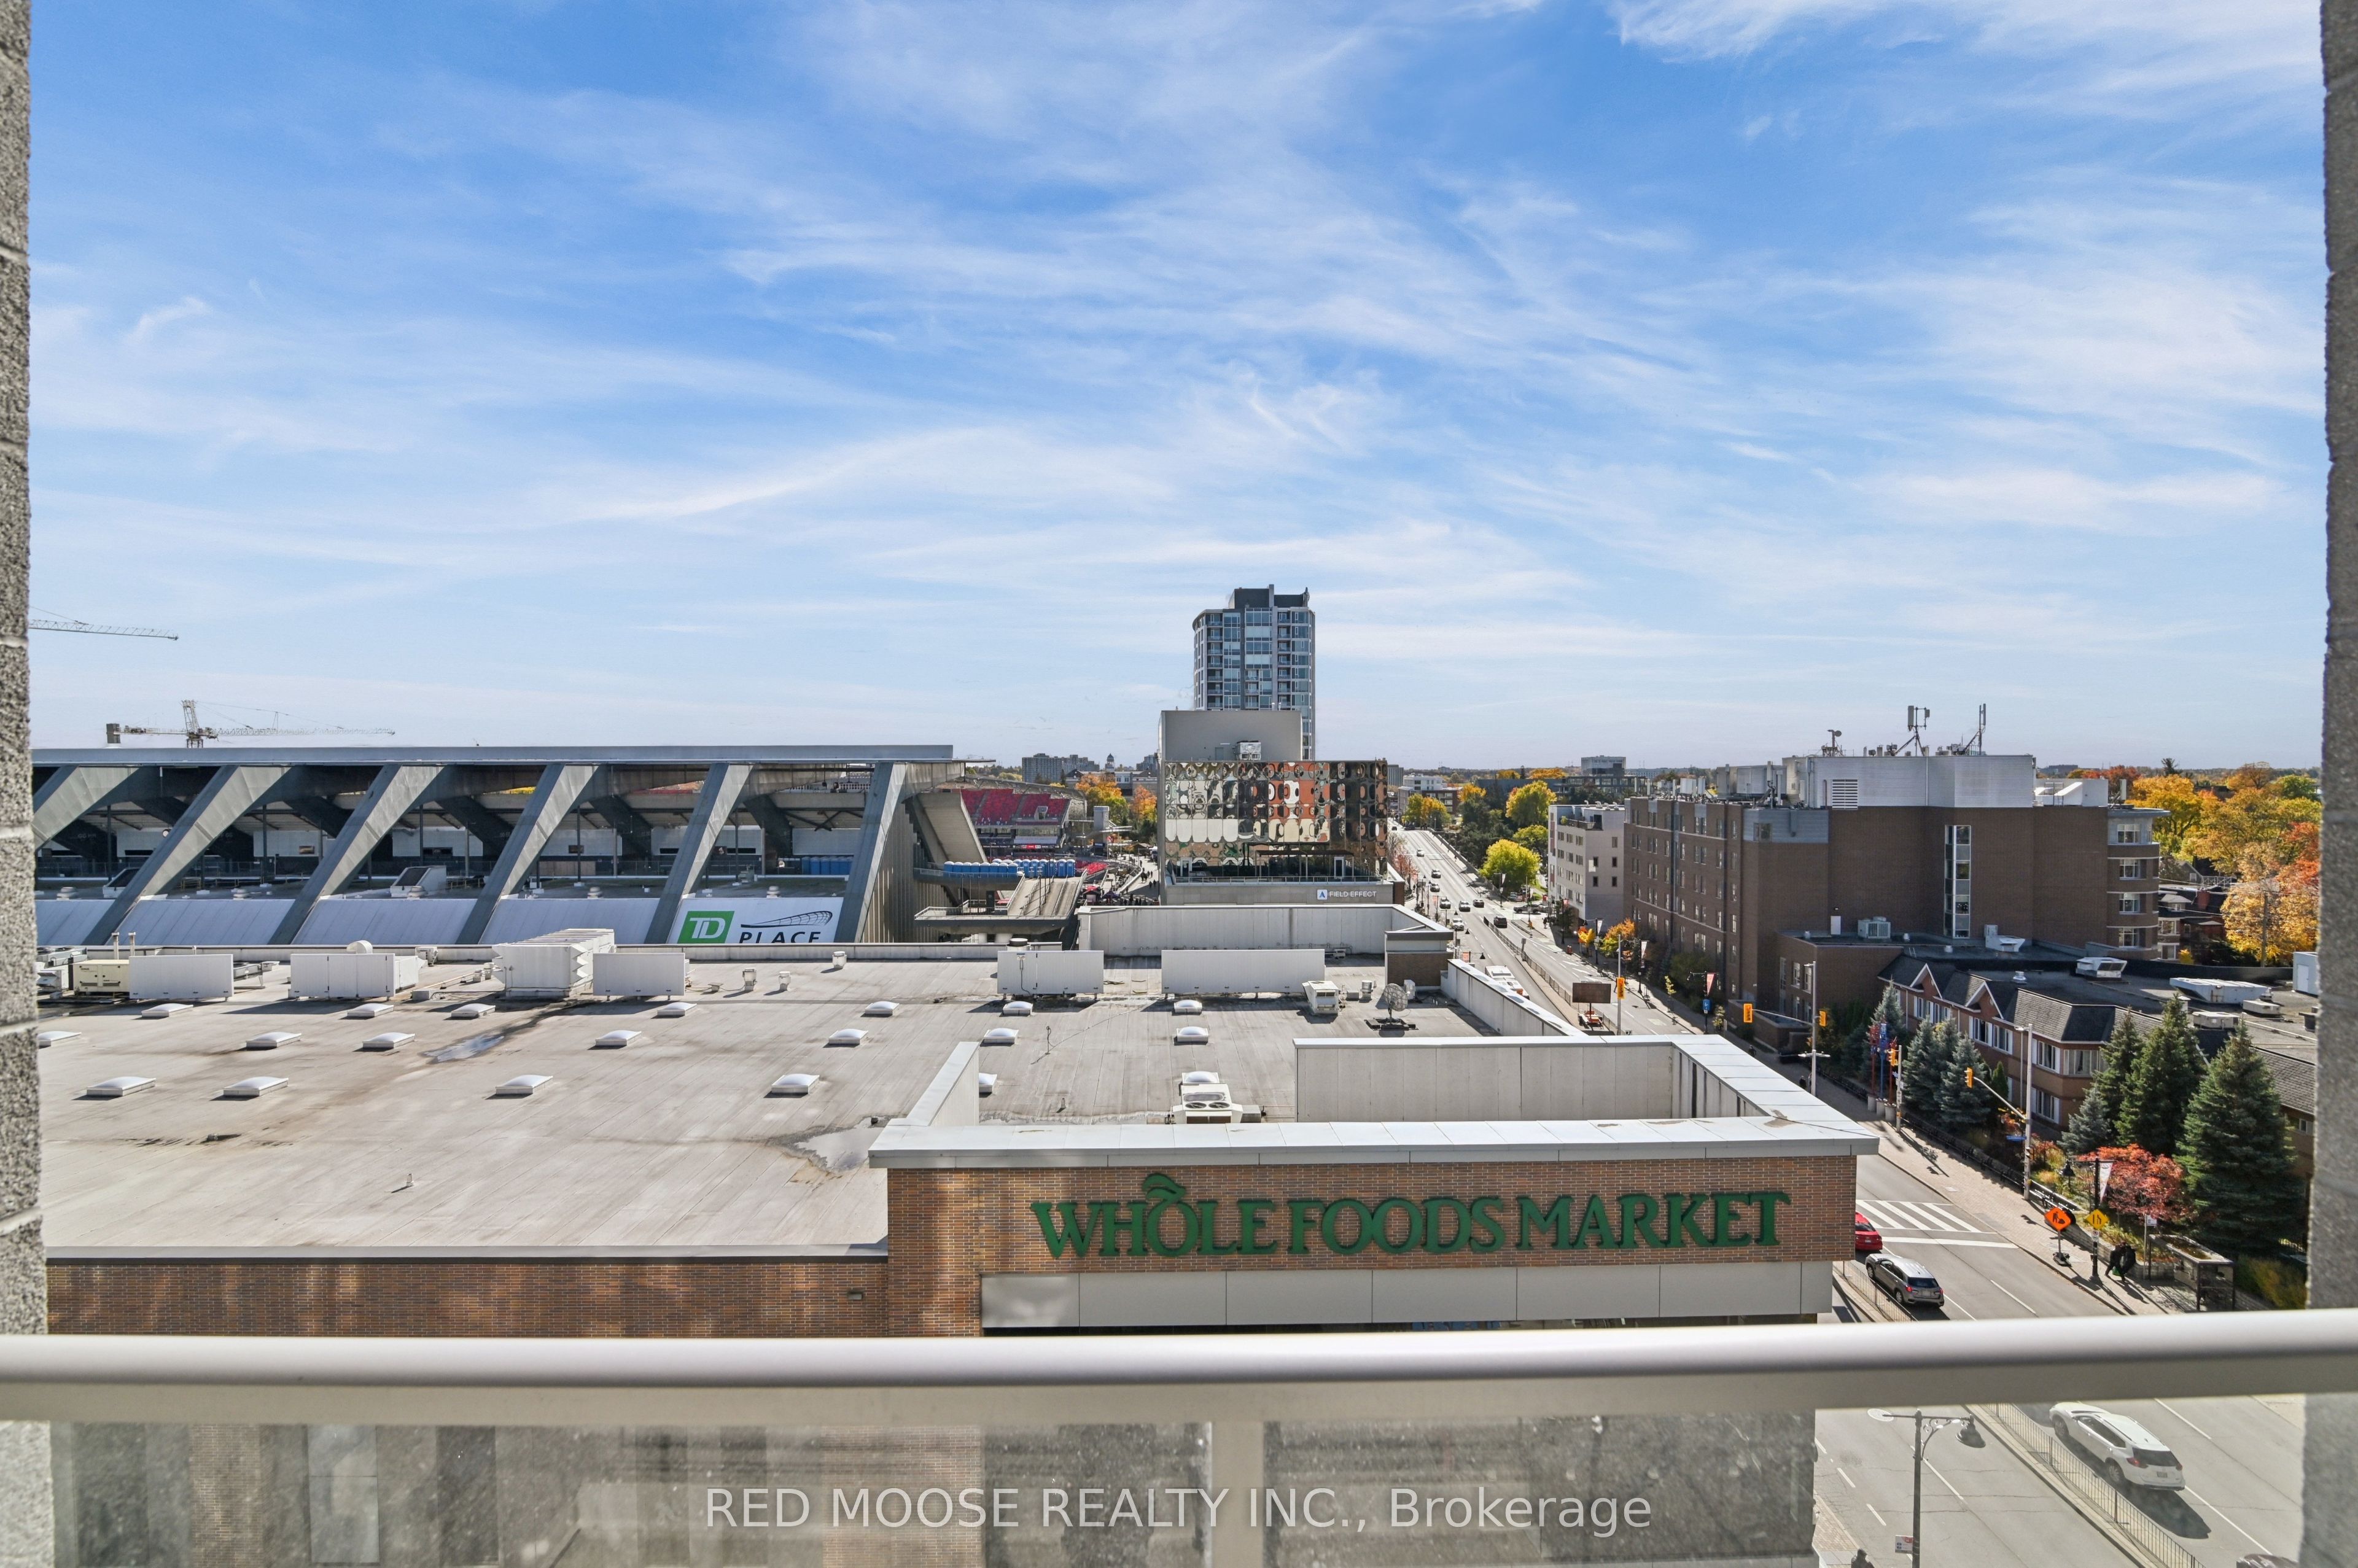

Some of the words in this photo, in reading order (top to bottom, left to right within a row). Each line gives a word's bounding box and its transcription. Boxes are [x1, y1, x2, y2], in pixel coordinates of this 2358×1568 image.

[690, 917, 726, 939] TD
[1030, 1197, 1279, 1259] WHOLE
[1287, 1197, 1506, 1255] FOODS
[1516, 1192, 1792, 1251] MARKET
